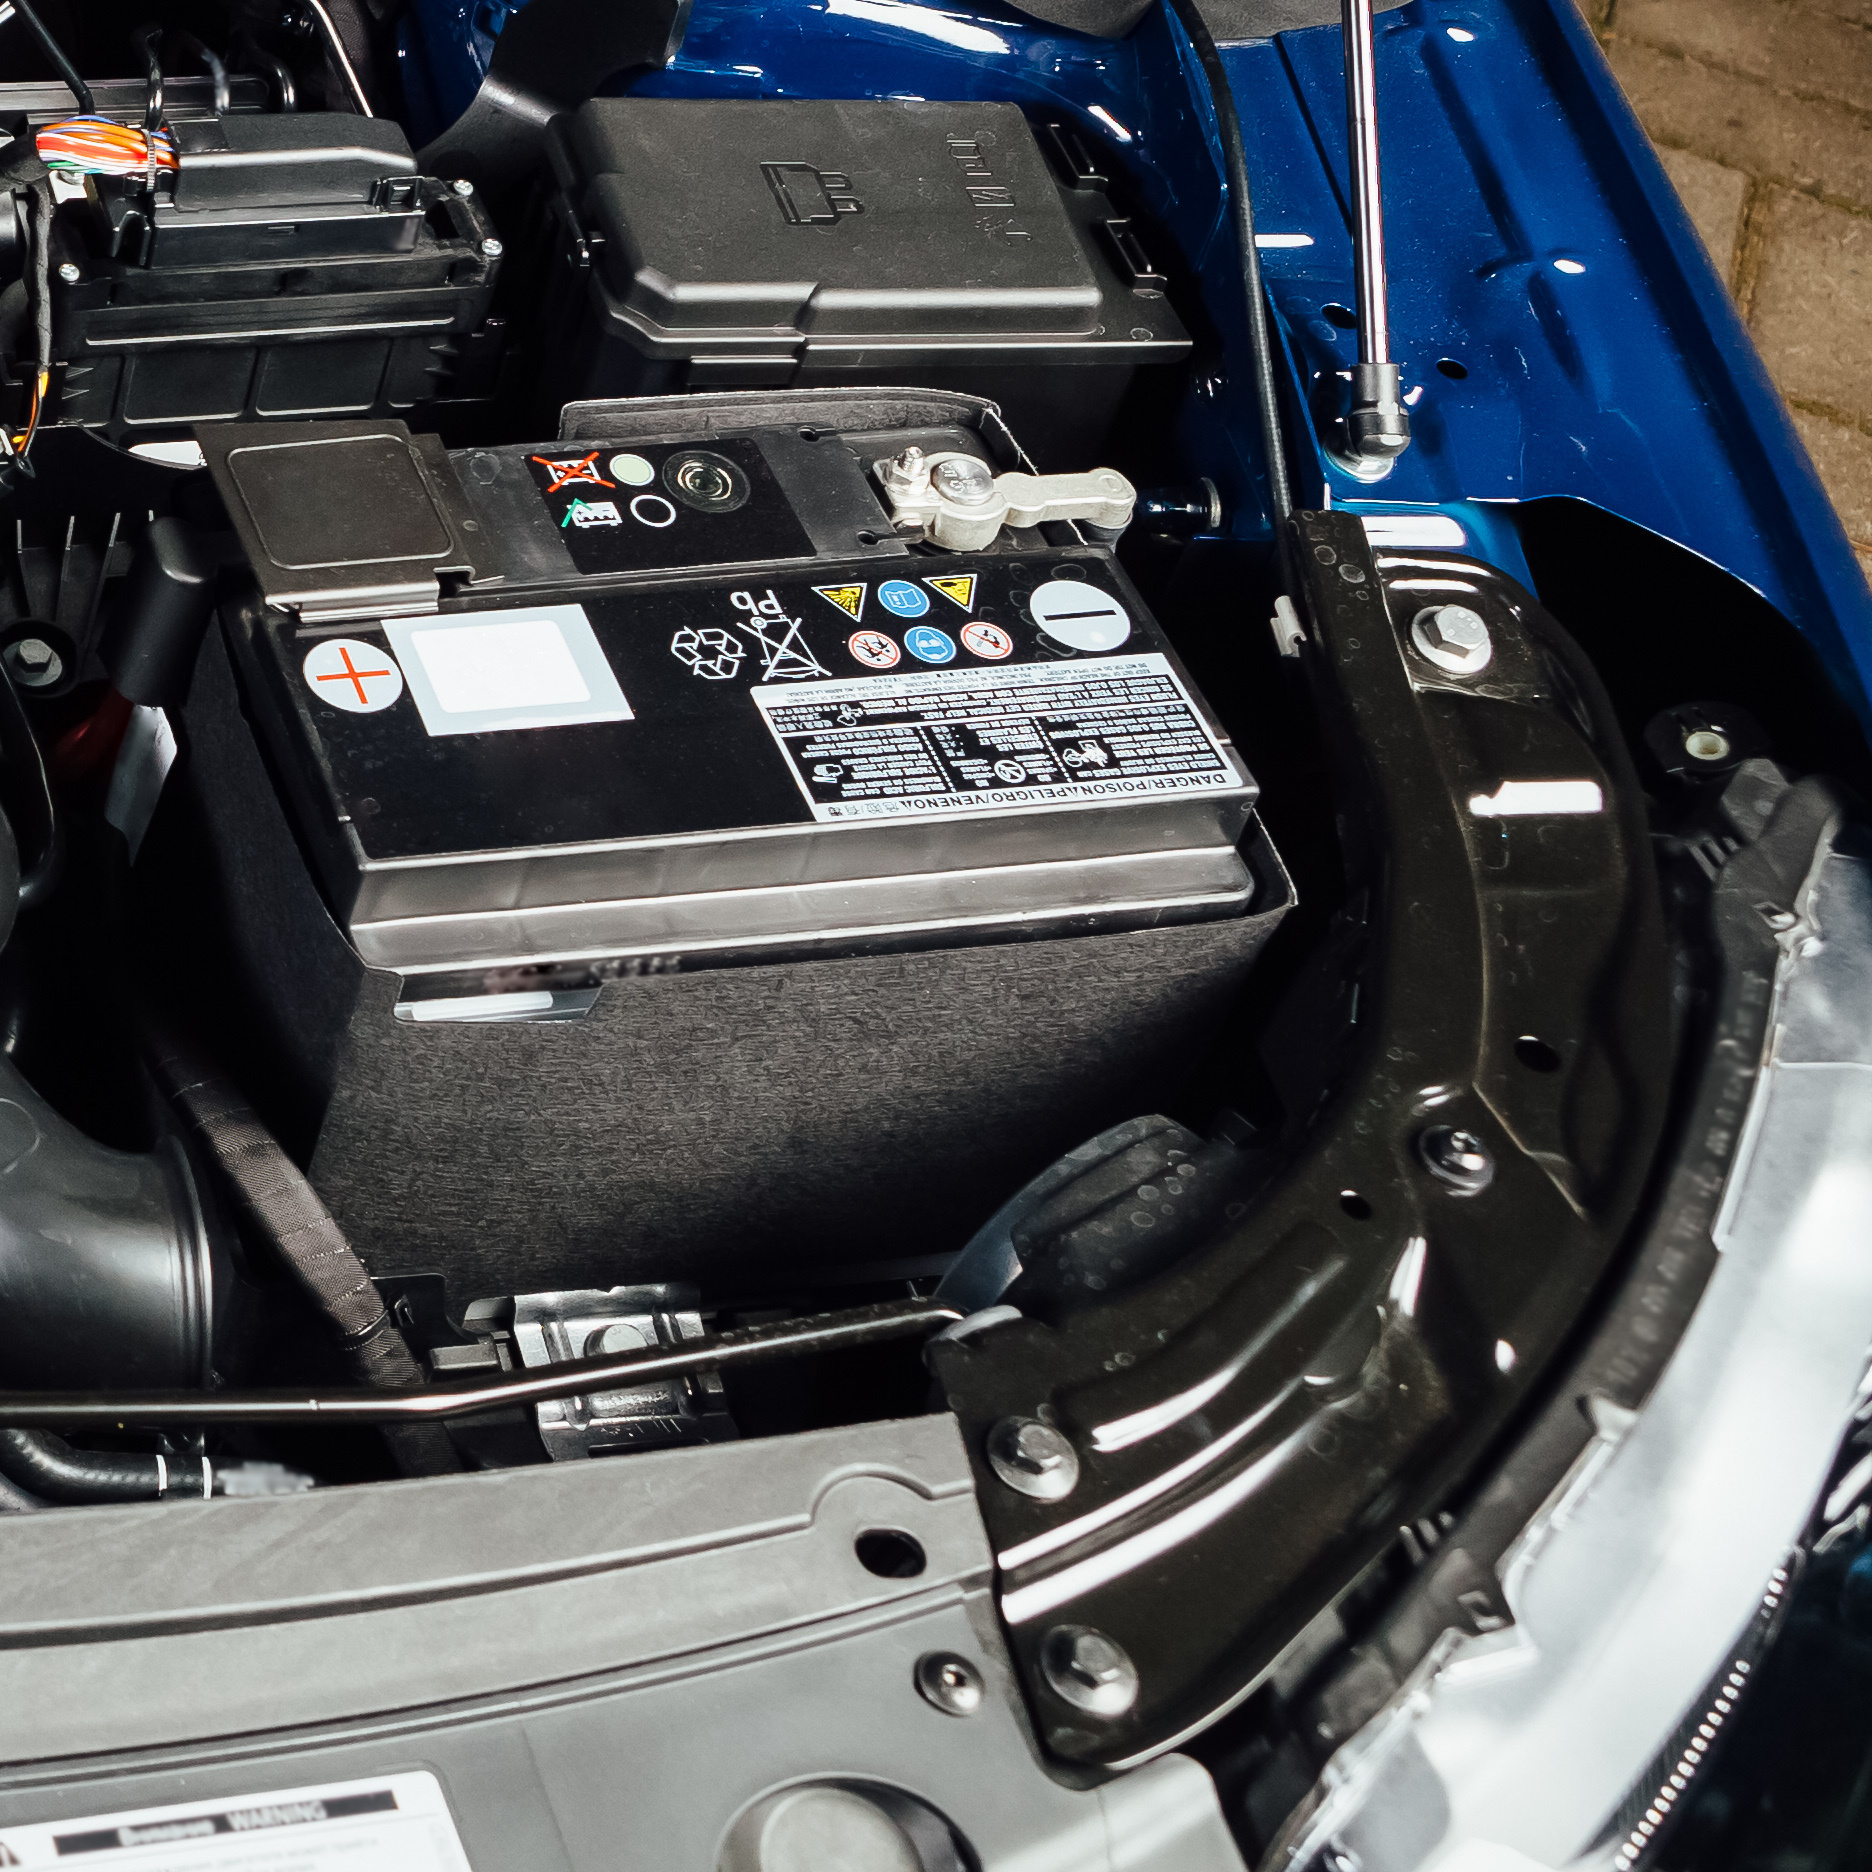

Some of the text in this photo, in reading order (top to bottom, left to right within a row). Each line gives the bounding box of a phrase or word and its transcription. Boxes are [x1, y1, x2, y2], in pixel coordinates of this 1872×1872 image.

[730, 589, 783, 616] Pb
[912, 774, 1226, 810] DANGER/POISON PELIGRO/VENENO
[226, 1800, 329, 1832] WARNING
